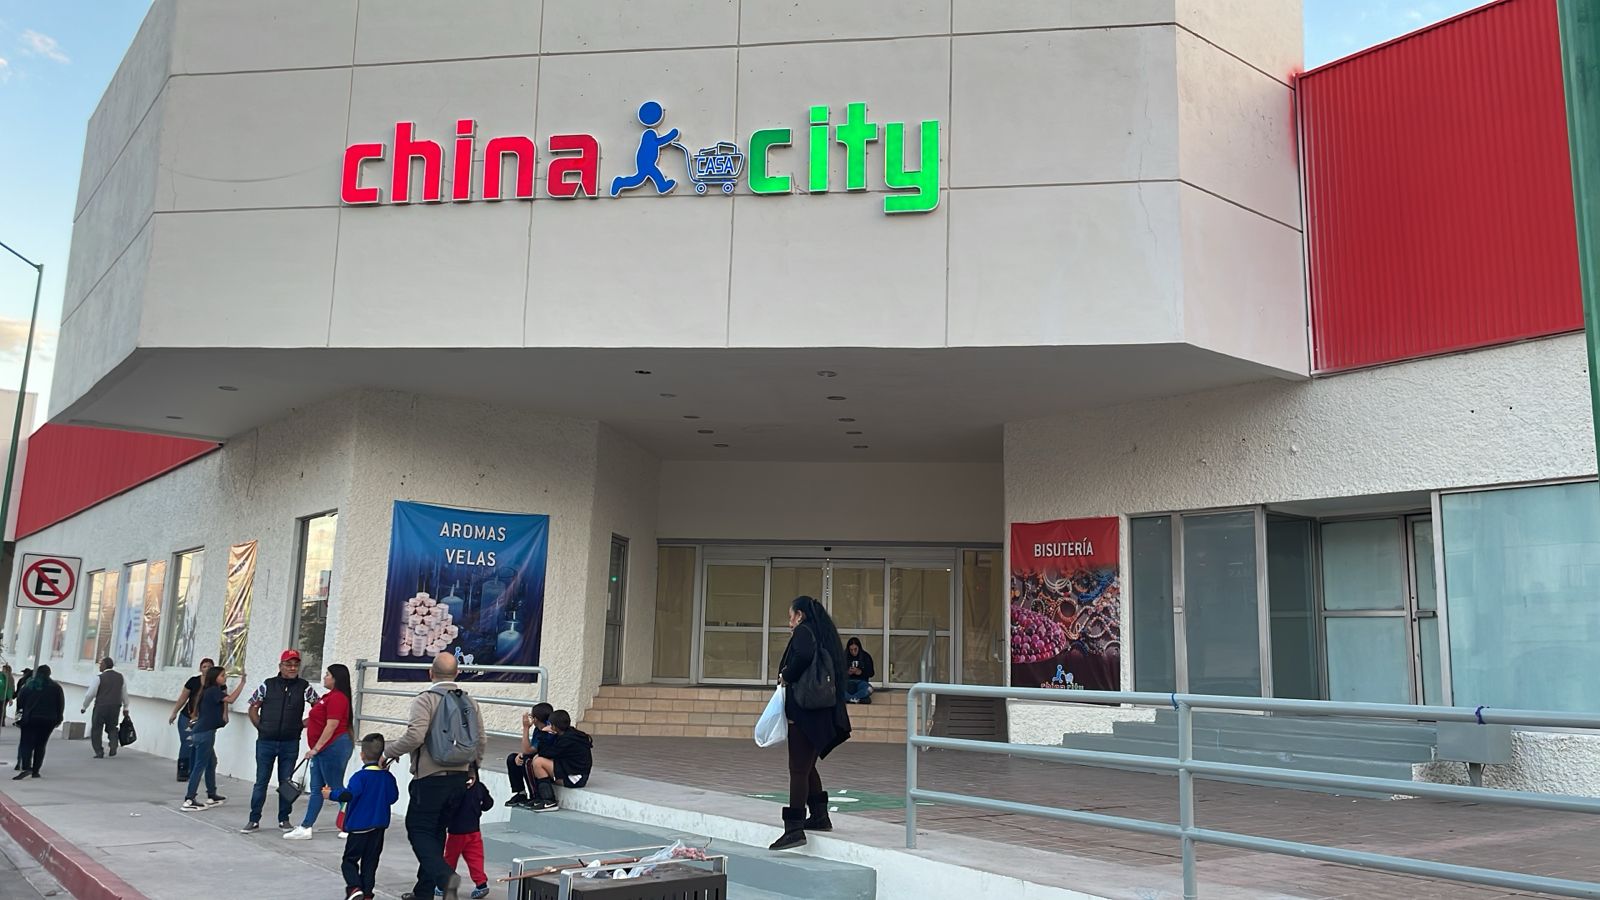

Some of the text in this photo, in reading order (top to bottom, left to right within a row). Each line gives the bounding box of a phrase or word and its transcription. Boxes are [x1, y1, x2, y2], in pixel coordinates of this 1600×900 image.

[341, 102, 940, 214] china city
[696, 156, 735, 175] CASA
[439, 522, 507, 541] AROMAS
[1034, 537, 1094, 557] BISUTERÍA
[445, 549, 496, 567] VELAS
[35, 567, 62, 596] E
